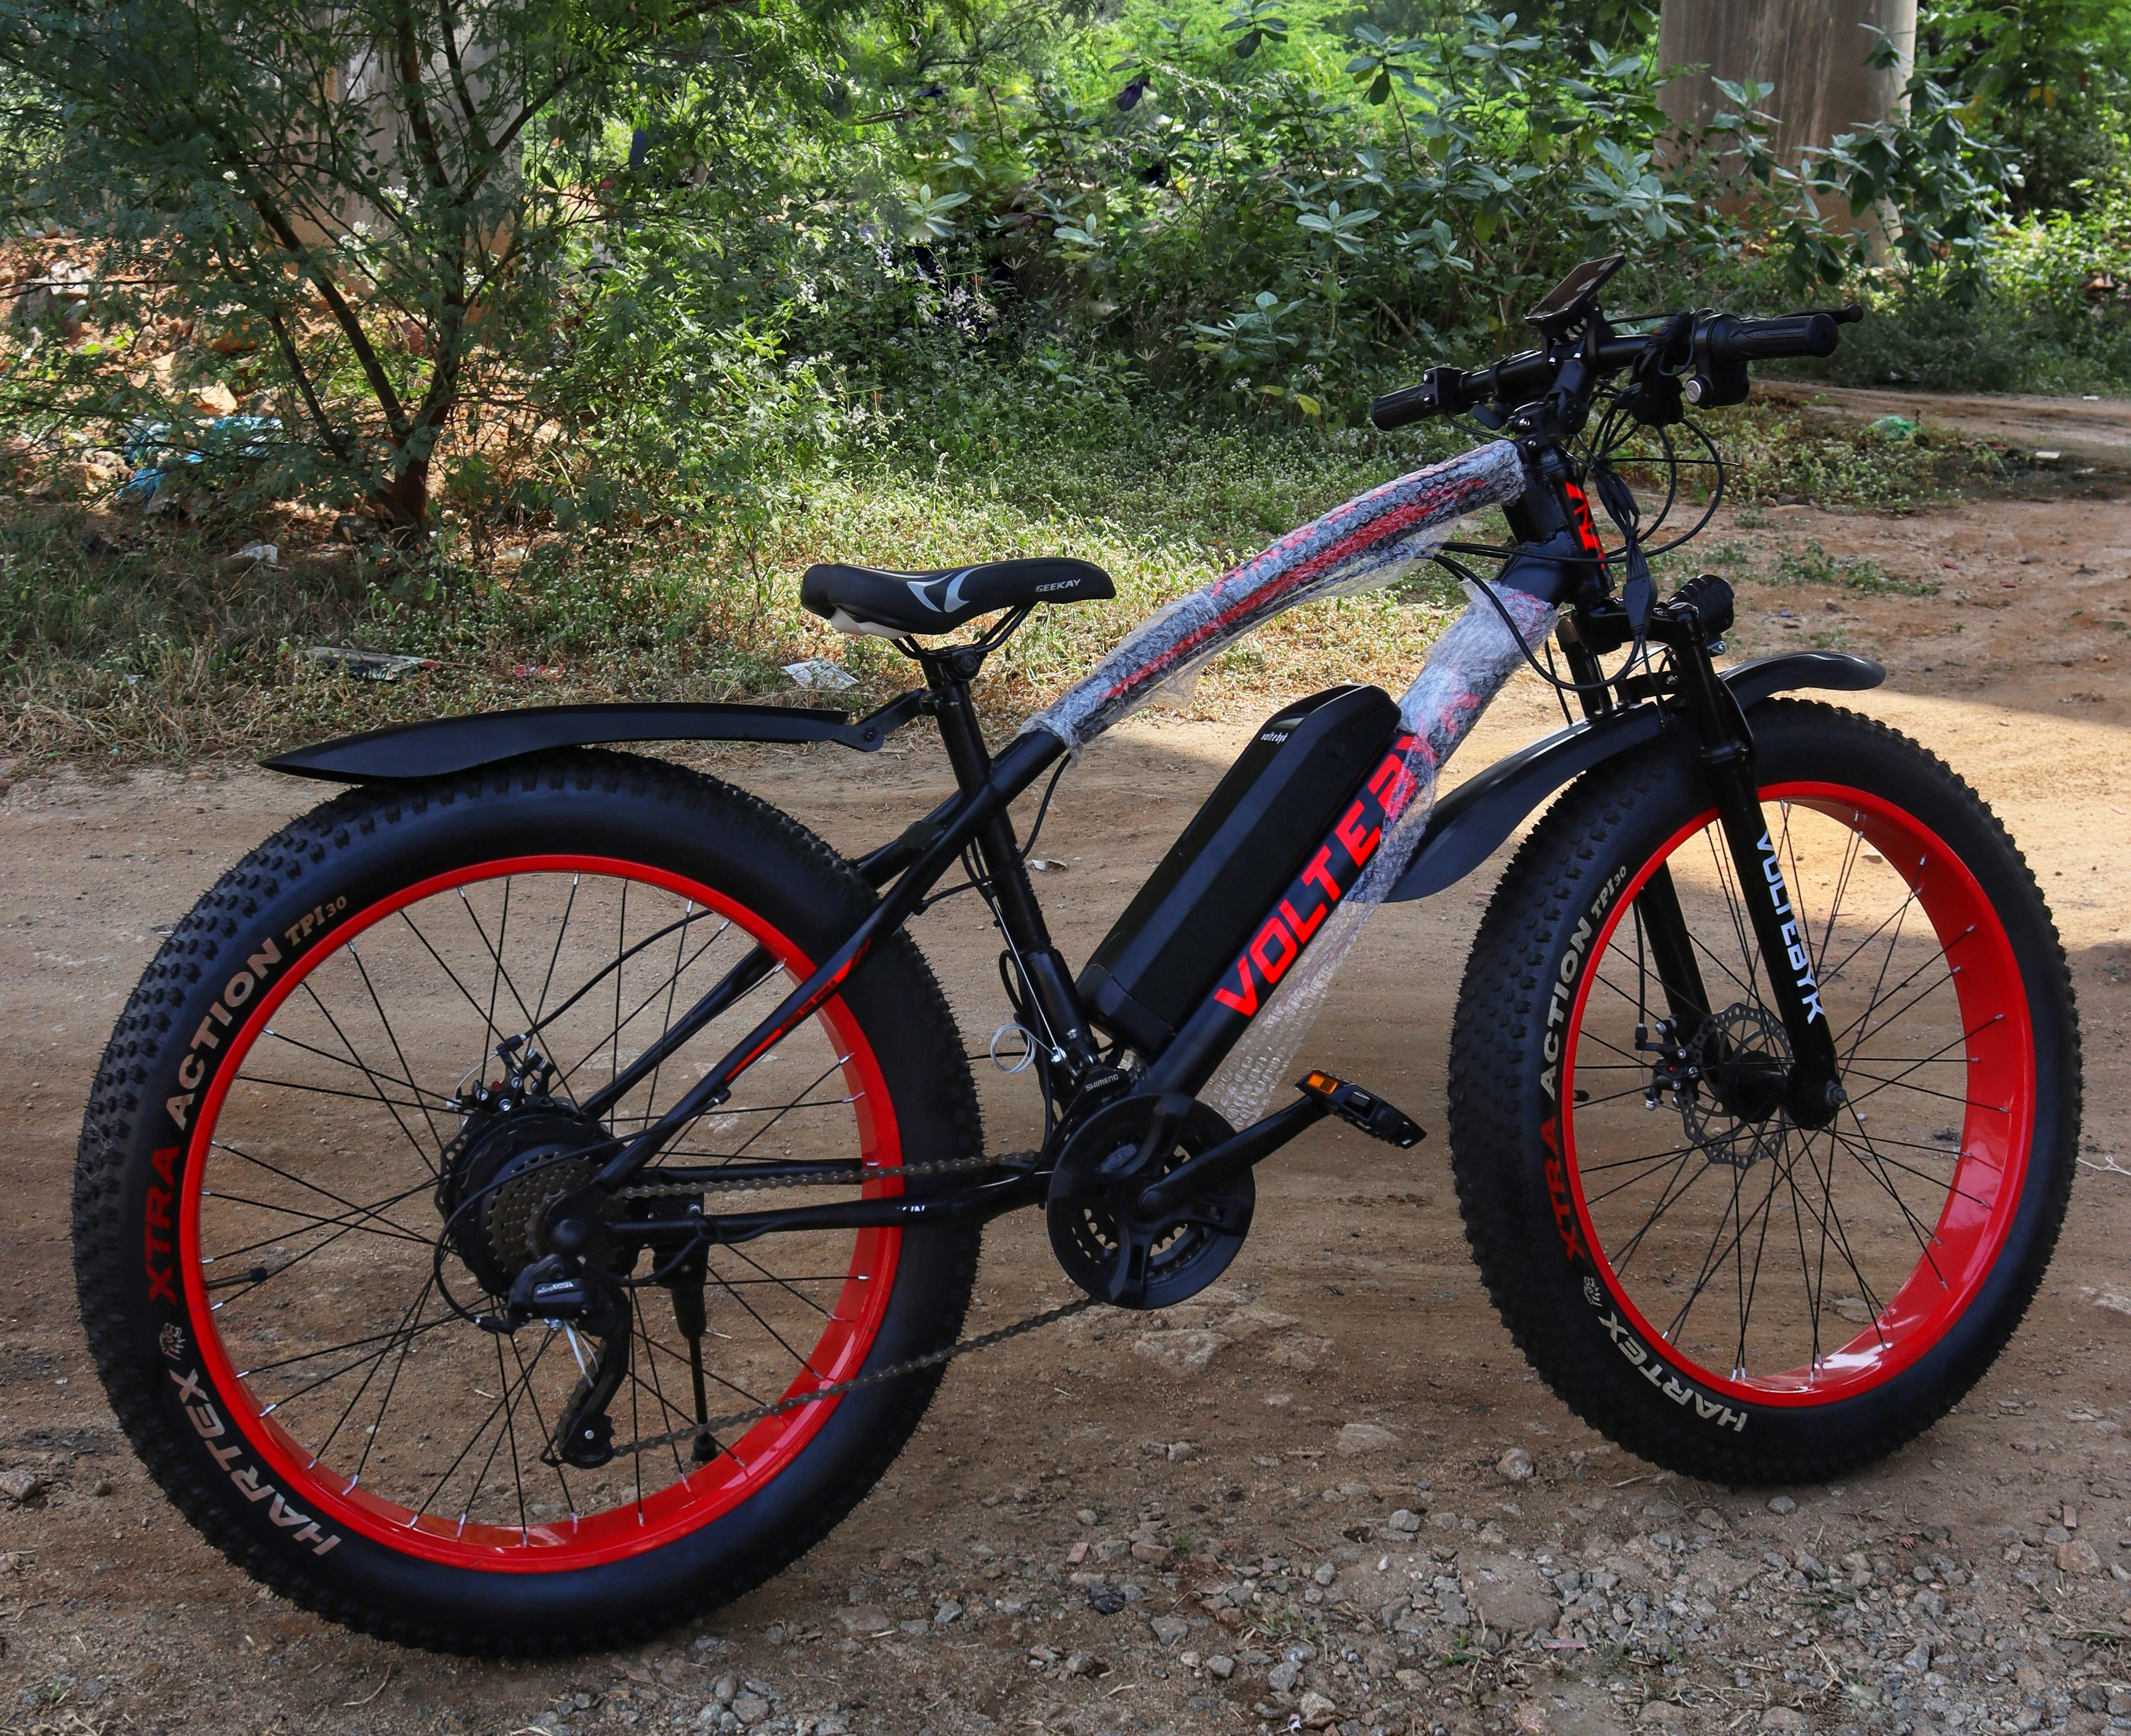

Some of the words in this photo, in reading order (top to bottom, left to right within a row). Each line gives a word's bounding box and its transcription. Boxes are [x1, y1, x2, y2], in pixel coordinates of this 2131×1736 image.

[1035, 578, 1081, 593] GEEKAY
[1540, 916, 1593, 1101] ACTION
[144, 1146, 180, 1306] XTRA
[166, 937, 283, 1131] ACTION
[1085, 1074, 1119, 1092] SHIMENG
[1540, 1117, 1585, 1262] XTRA
[1598, 1311, 1748, 1432] HARTEX
[169, 1368, 341, 1556] HARTEX
